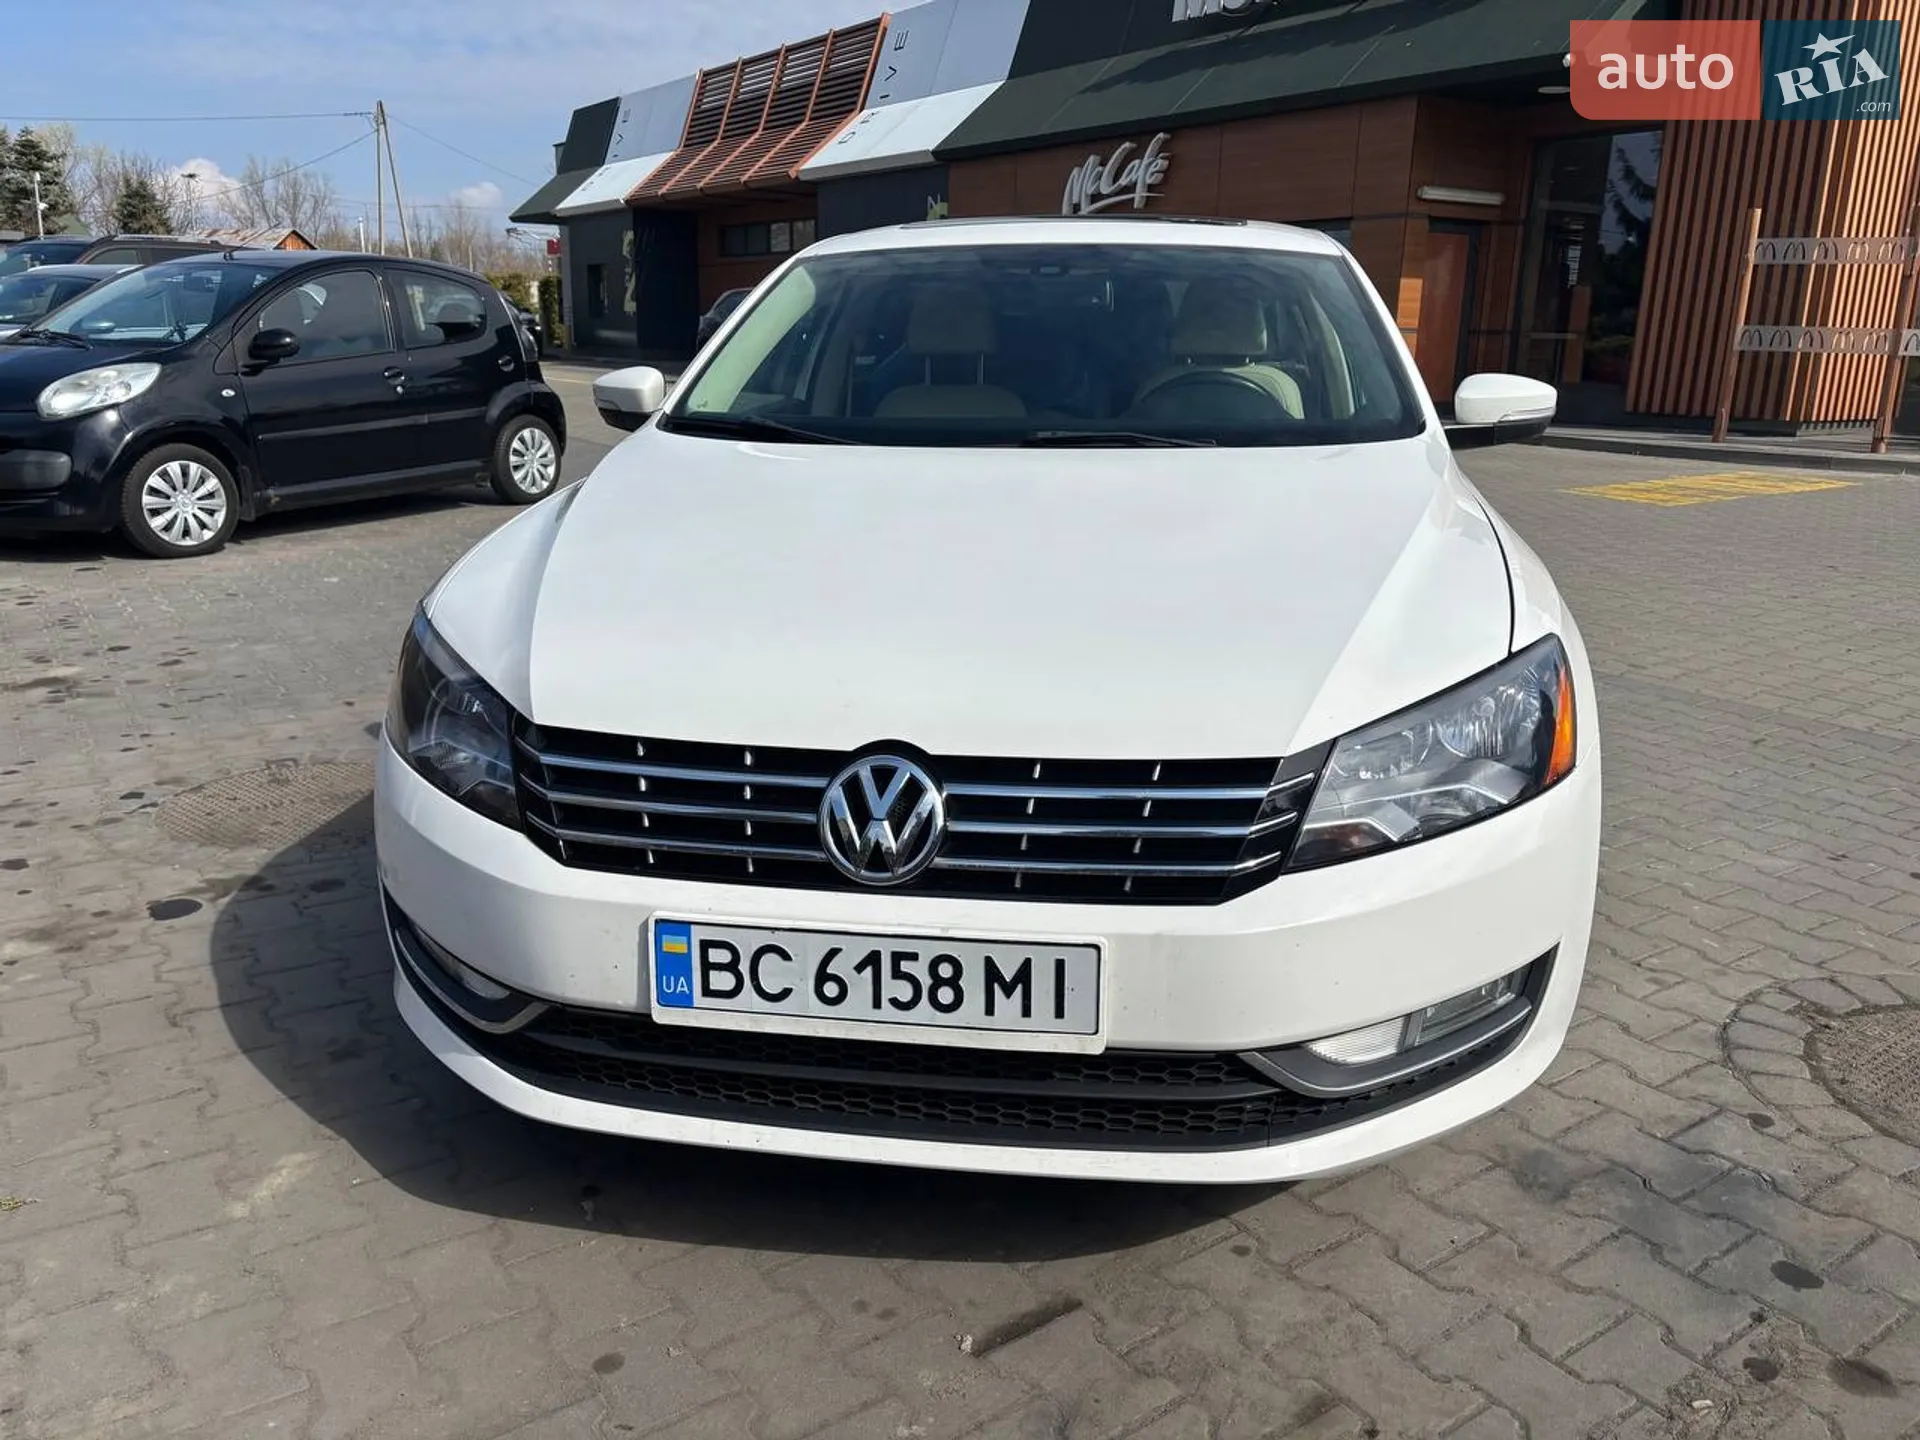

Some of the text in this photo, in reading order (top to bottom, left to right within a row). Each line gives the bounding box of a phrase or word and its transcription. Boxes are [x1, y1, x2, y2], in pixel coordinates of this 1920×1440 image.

[1062, 132, 1172, 216] McCafé
[663, 975, 691, 995] UA
[698, 938, 1067, 1020] BC 6158 MI
